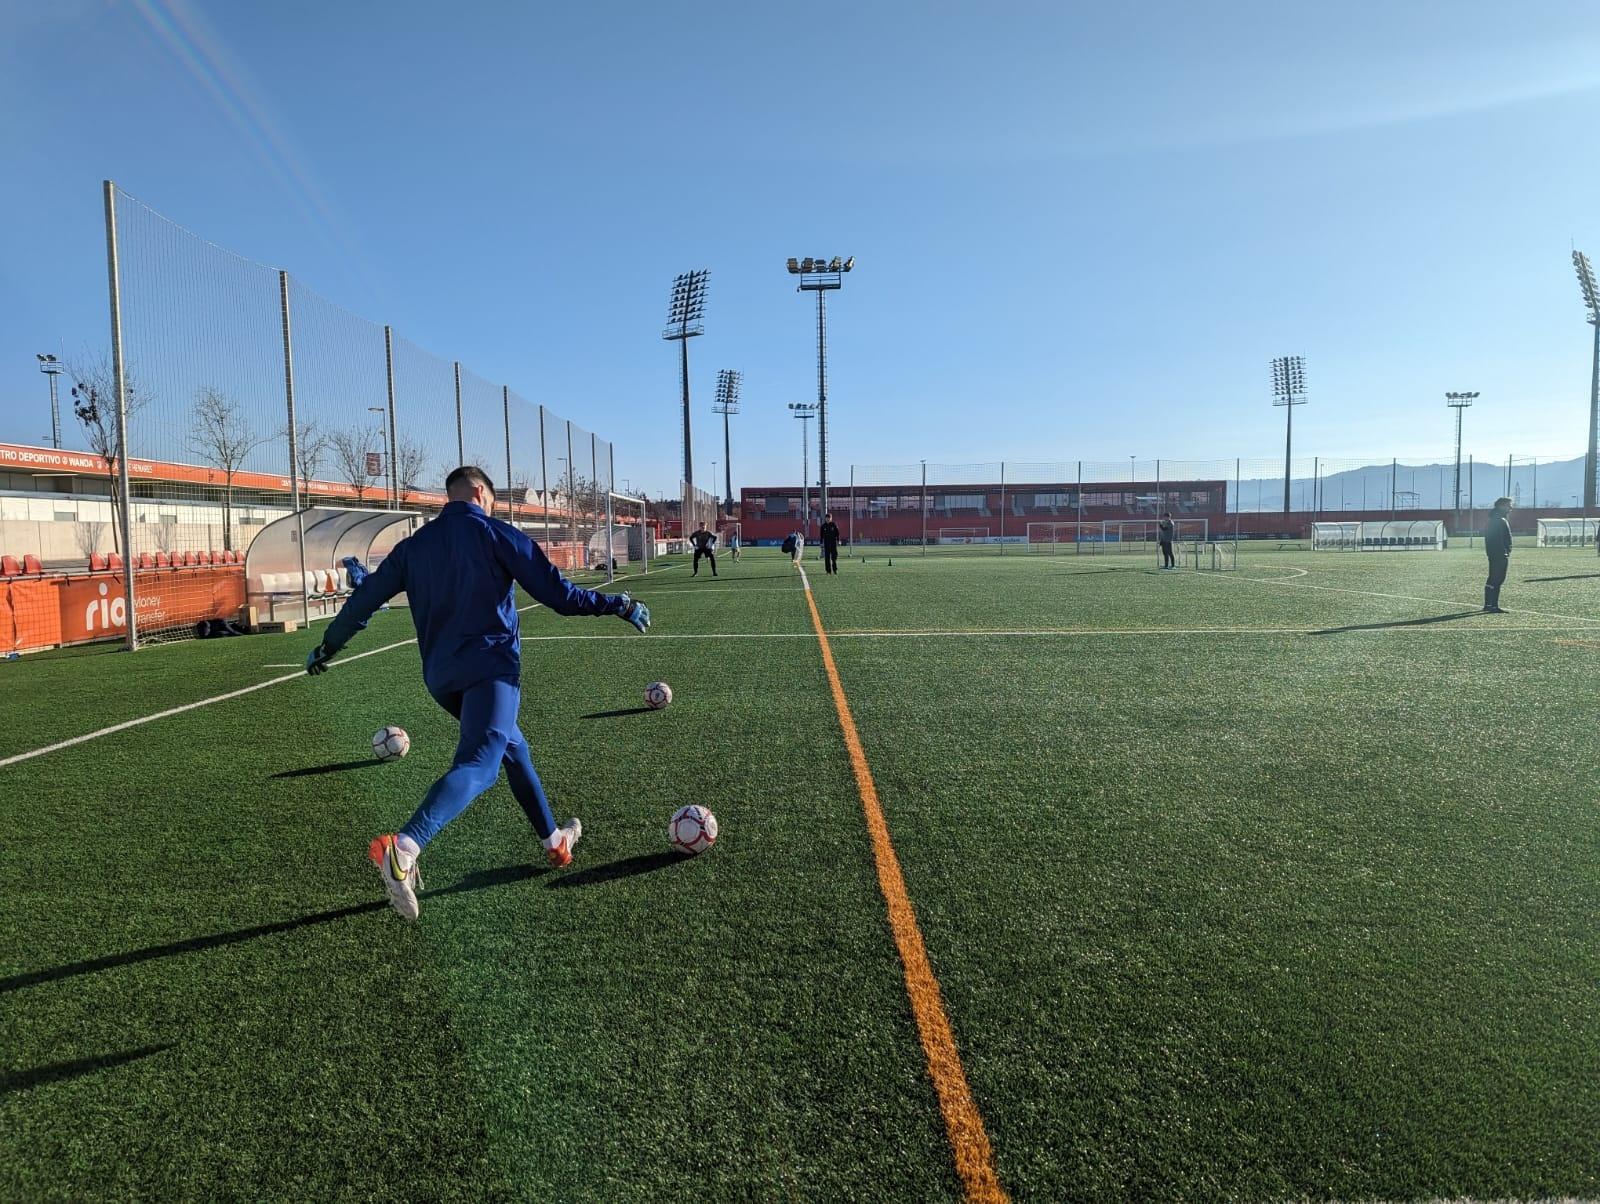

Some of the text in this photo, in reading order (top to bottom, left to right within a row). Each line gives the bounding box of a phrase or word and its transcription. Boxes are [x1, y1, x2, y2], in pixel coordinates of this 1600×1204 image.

[19, 452, 61, 465] DEPORTIVO
[69, 457, 94, 468] WANDA
[86, 582, 126, 631] ria
